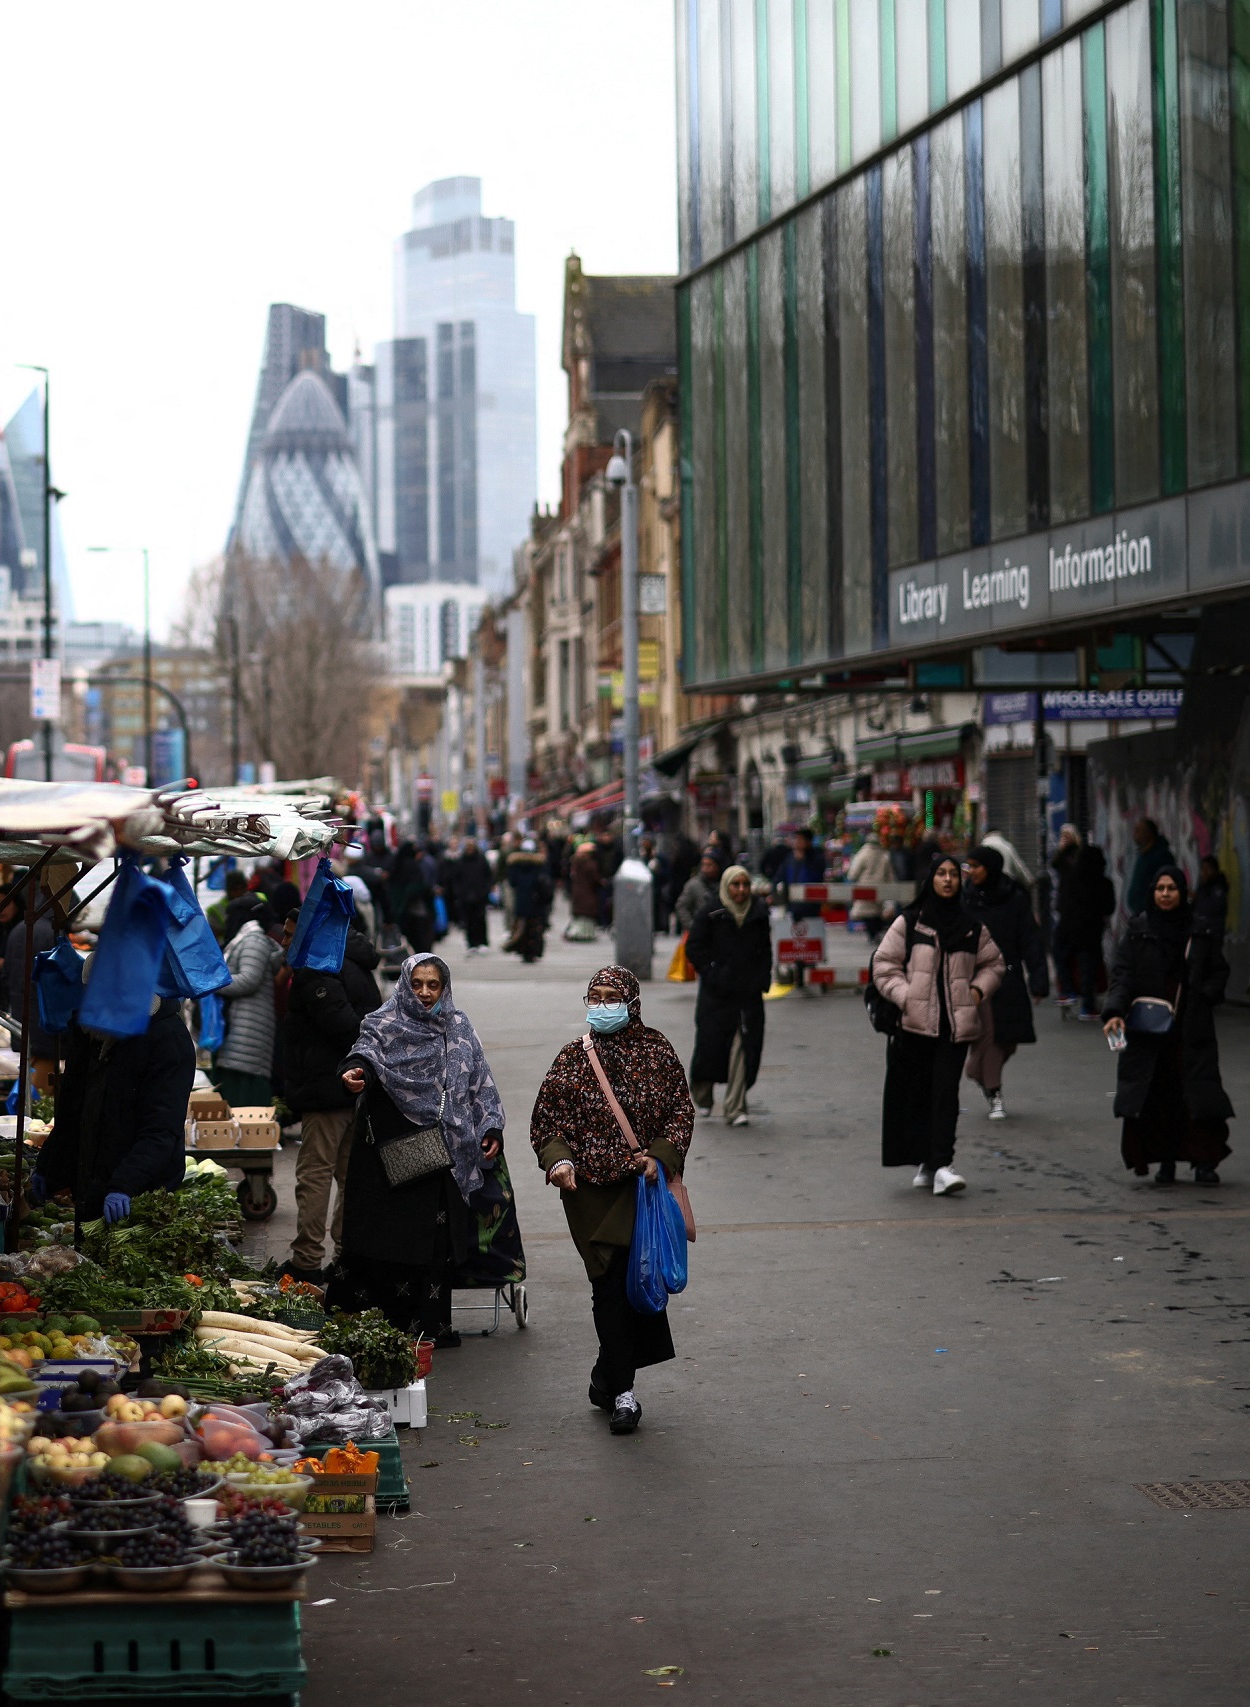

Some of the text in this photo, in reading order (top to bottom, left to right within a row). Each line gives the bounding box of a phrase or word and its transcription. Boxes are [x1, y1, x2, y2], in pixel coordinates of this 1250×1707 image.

[899, 529, 1151, 624] Library Learning Information
